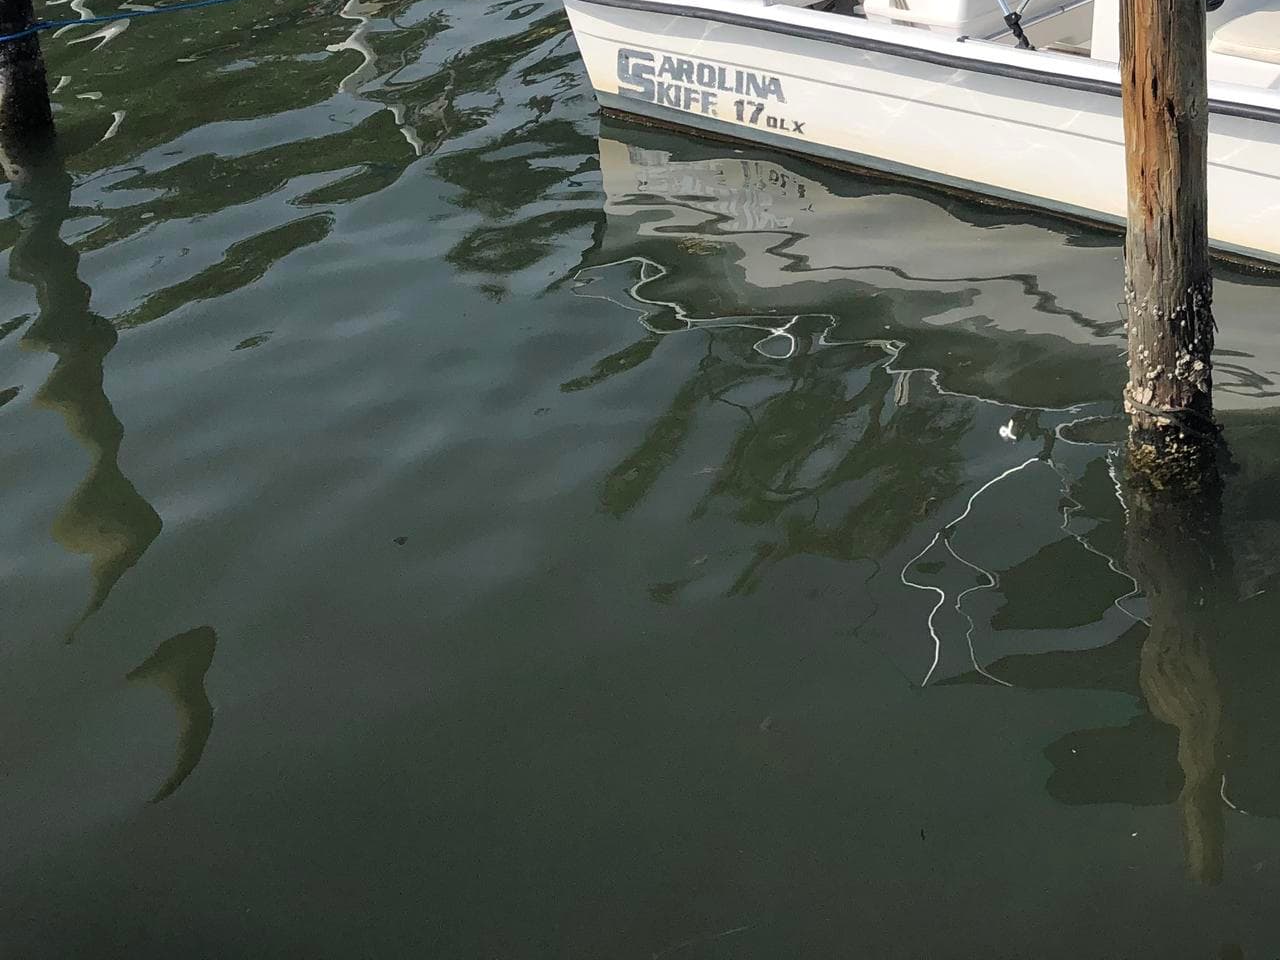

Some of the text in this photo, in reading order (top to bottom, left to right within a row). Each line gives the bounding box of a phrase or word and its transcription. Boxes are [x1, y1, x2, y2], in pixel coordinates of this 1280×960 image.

[617, 48, 787, 104] CAROLINA
[617, 63, 719, 118] SKIFF
[734, 98, 765, 125] 17
